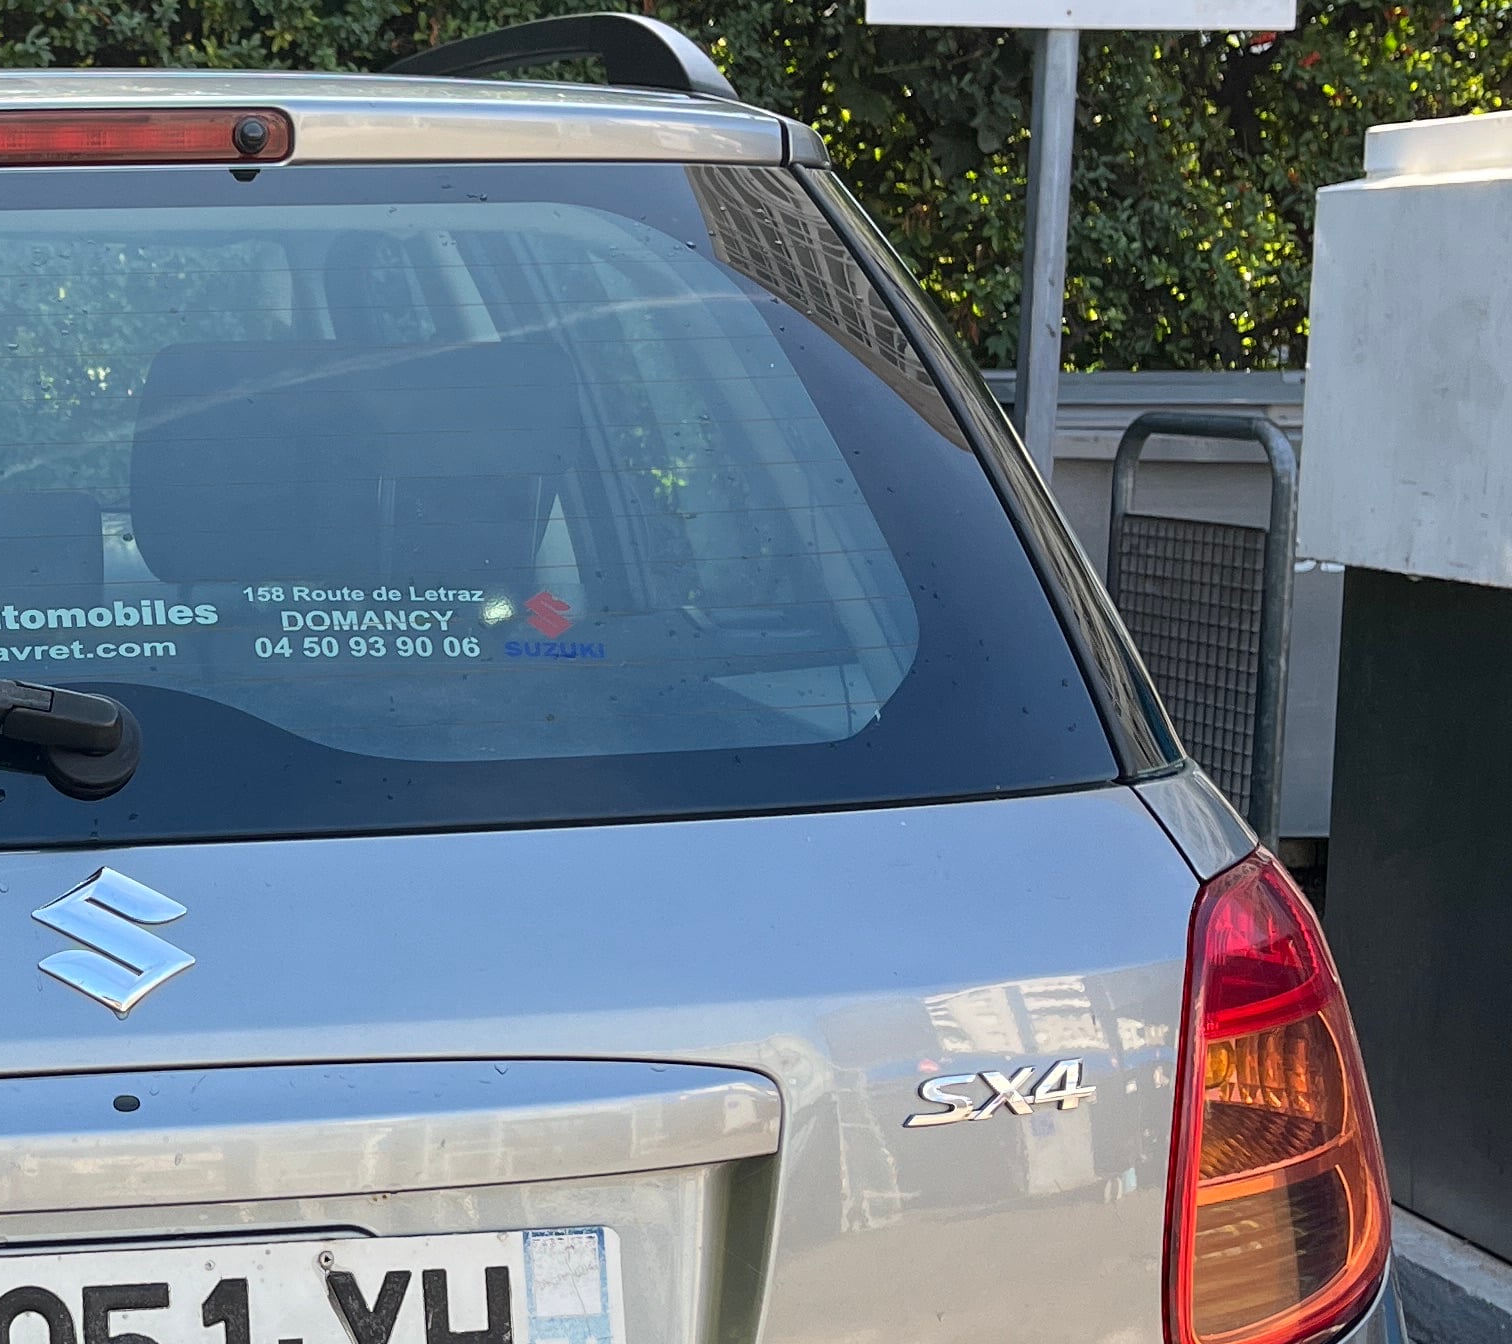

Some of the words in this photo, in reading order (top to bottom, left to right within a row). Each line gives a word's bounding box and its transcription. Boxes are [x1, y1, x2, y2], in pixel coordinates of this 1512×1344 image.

[243, 586, 285, 602] 158
[292, 586, 365, 602] Route
[371, 586, 402, 602] de
[408, 585, 485, 602] Letraz
[280, 609, 454, 632] DOMANCY
[254, 636, 292, 658] 04
[302, 637, 339, 657] 50
[349, 637, 387, 657] 93
[396, 637, 433, 657] 90
[442, 636, 481, 657] 06
[504, 640, 607, 658] SUZUKI
[902, 1057, 1097, 1128] SX4
